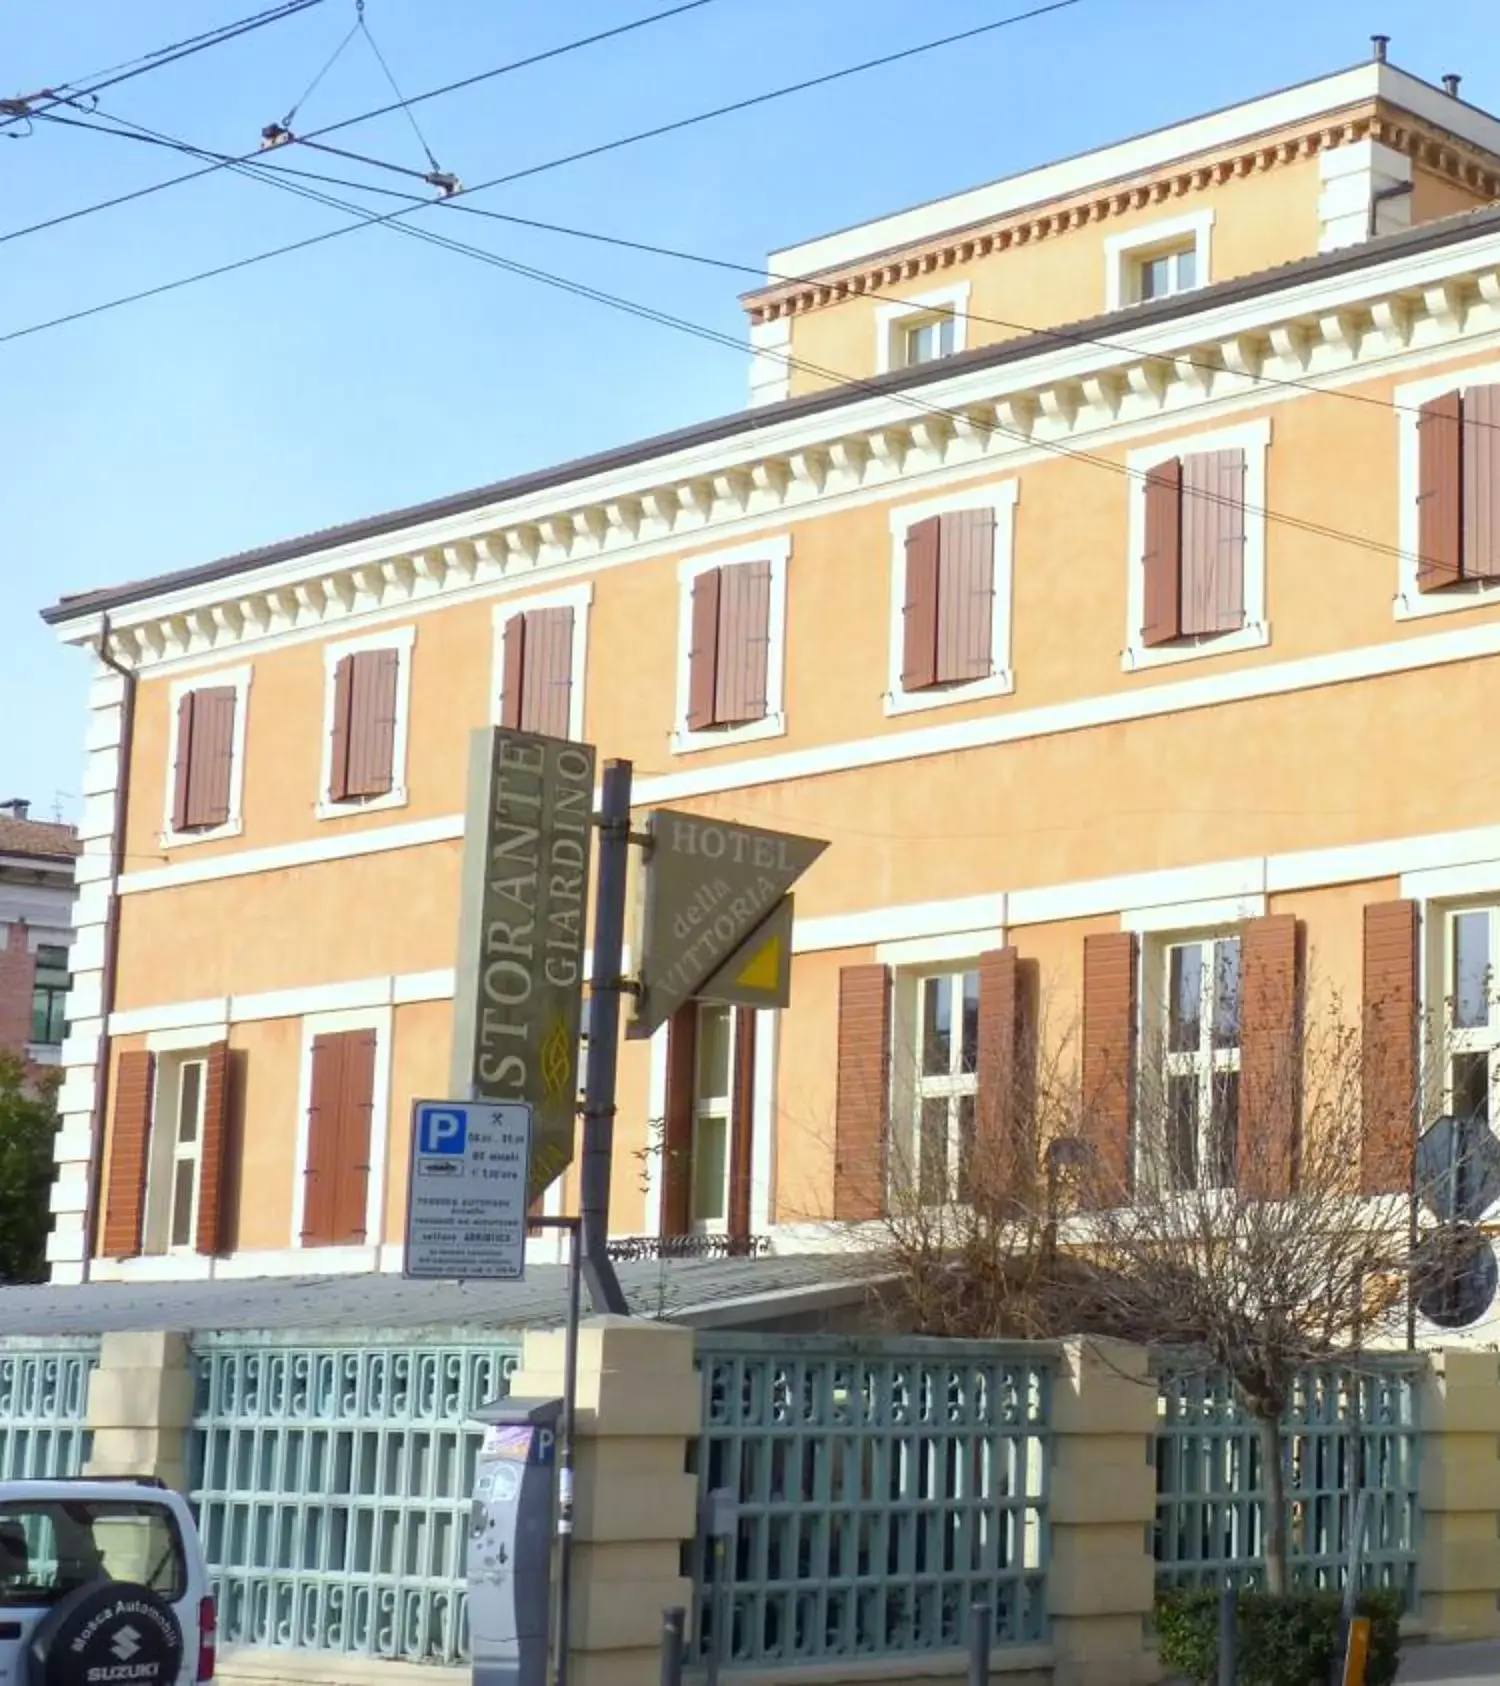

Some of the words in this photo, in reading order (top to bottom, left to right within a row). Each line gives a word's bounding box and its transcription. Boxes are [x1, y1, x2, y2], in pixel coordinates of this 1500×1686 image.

[544, 750, 589, 987] GIARDINO
[672, 821, 796, 871] HOTEL
[479, 739, 544, 1103] ISTORANTE
[656, 875, 775, 997] VITTORIA
[672, 877, 732, 939] della
[428, 1112, 460, 1151] P
[70, 1608, 112, 1652] Mosca
[87, 1662, 160, 1682] SUZUKI
